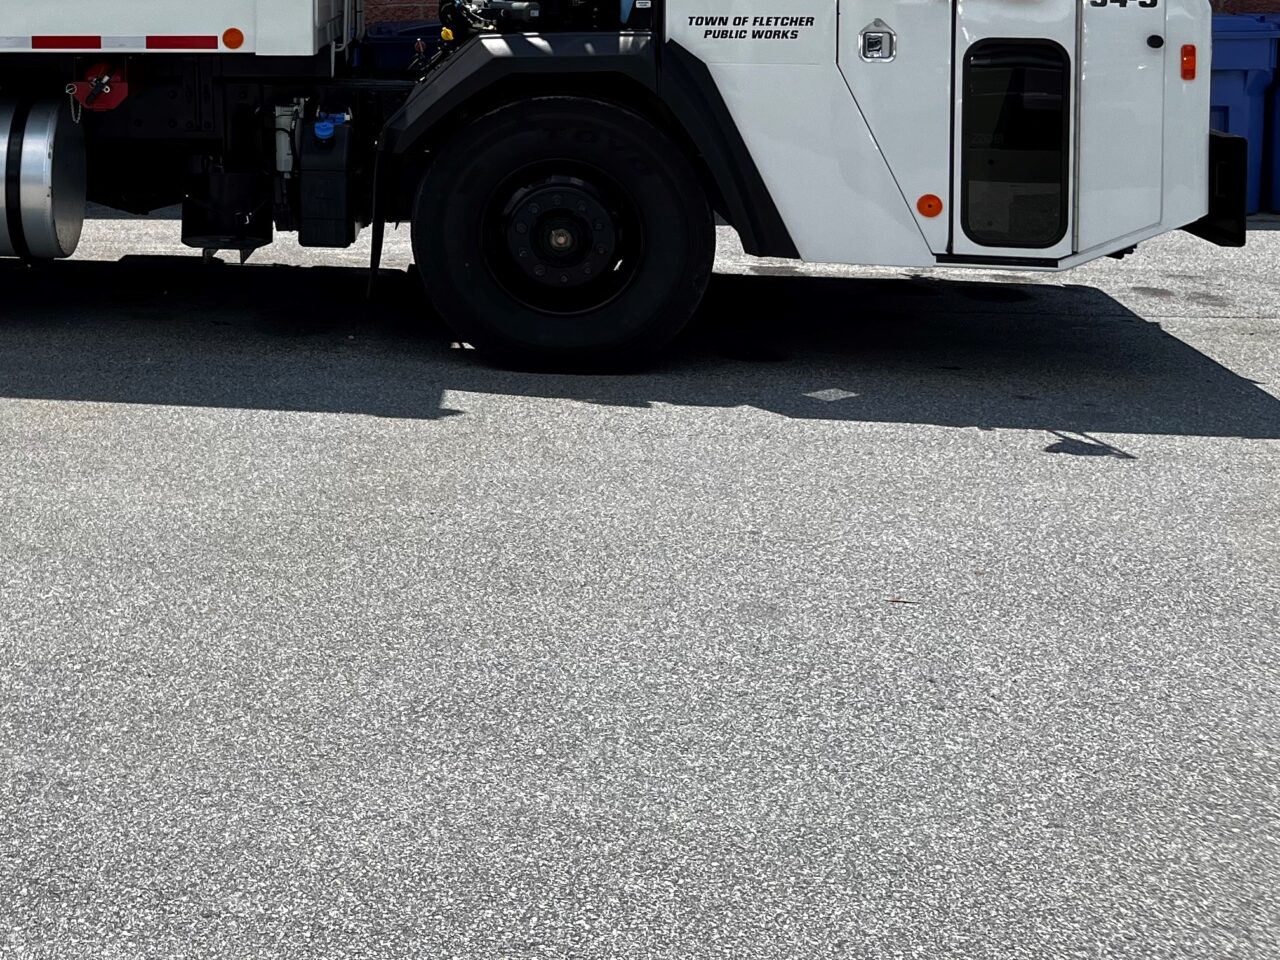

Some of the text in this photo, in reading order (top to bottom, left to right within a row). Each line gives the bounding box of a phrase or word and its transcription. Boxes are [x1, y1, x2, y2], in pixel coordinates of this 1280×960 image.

[688, 16, 815, 26] TOWN OF FLETCHER
[703, 30, 799, 39] PUBLIC WORKS
